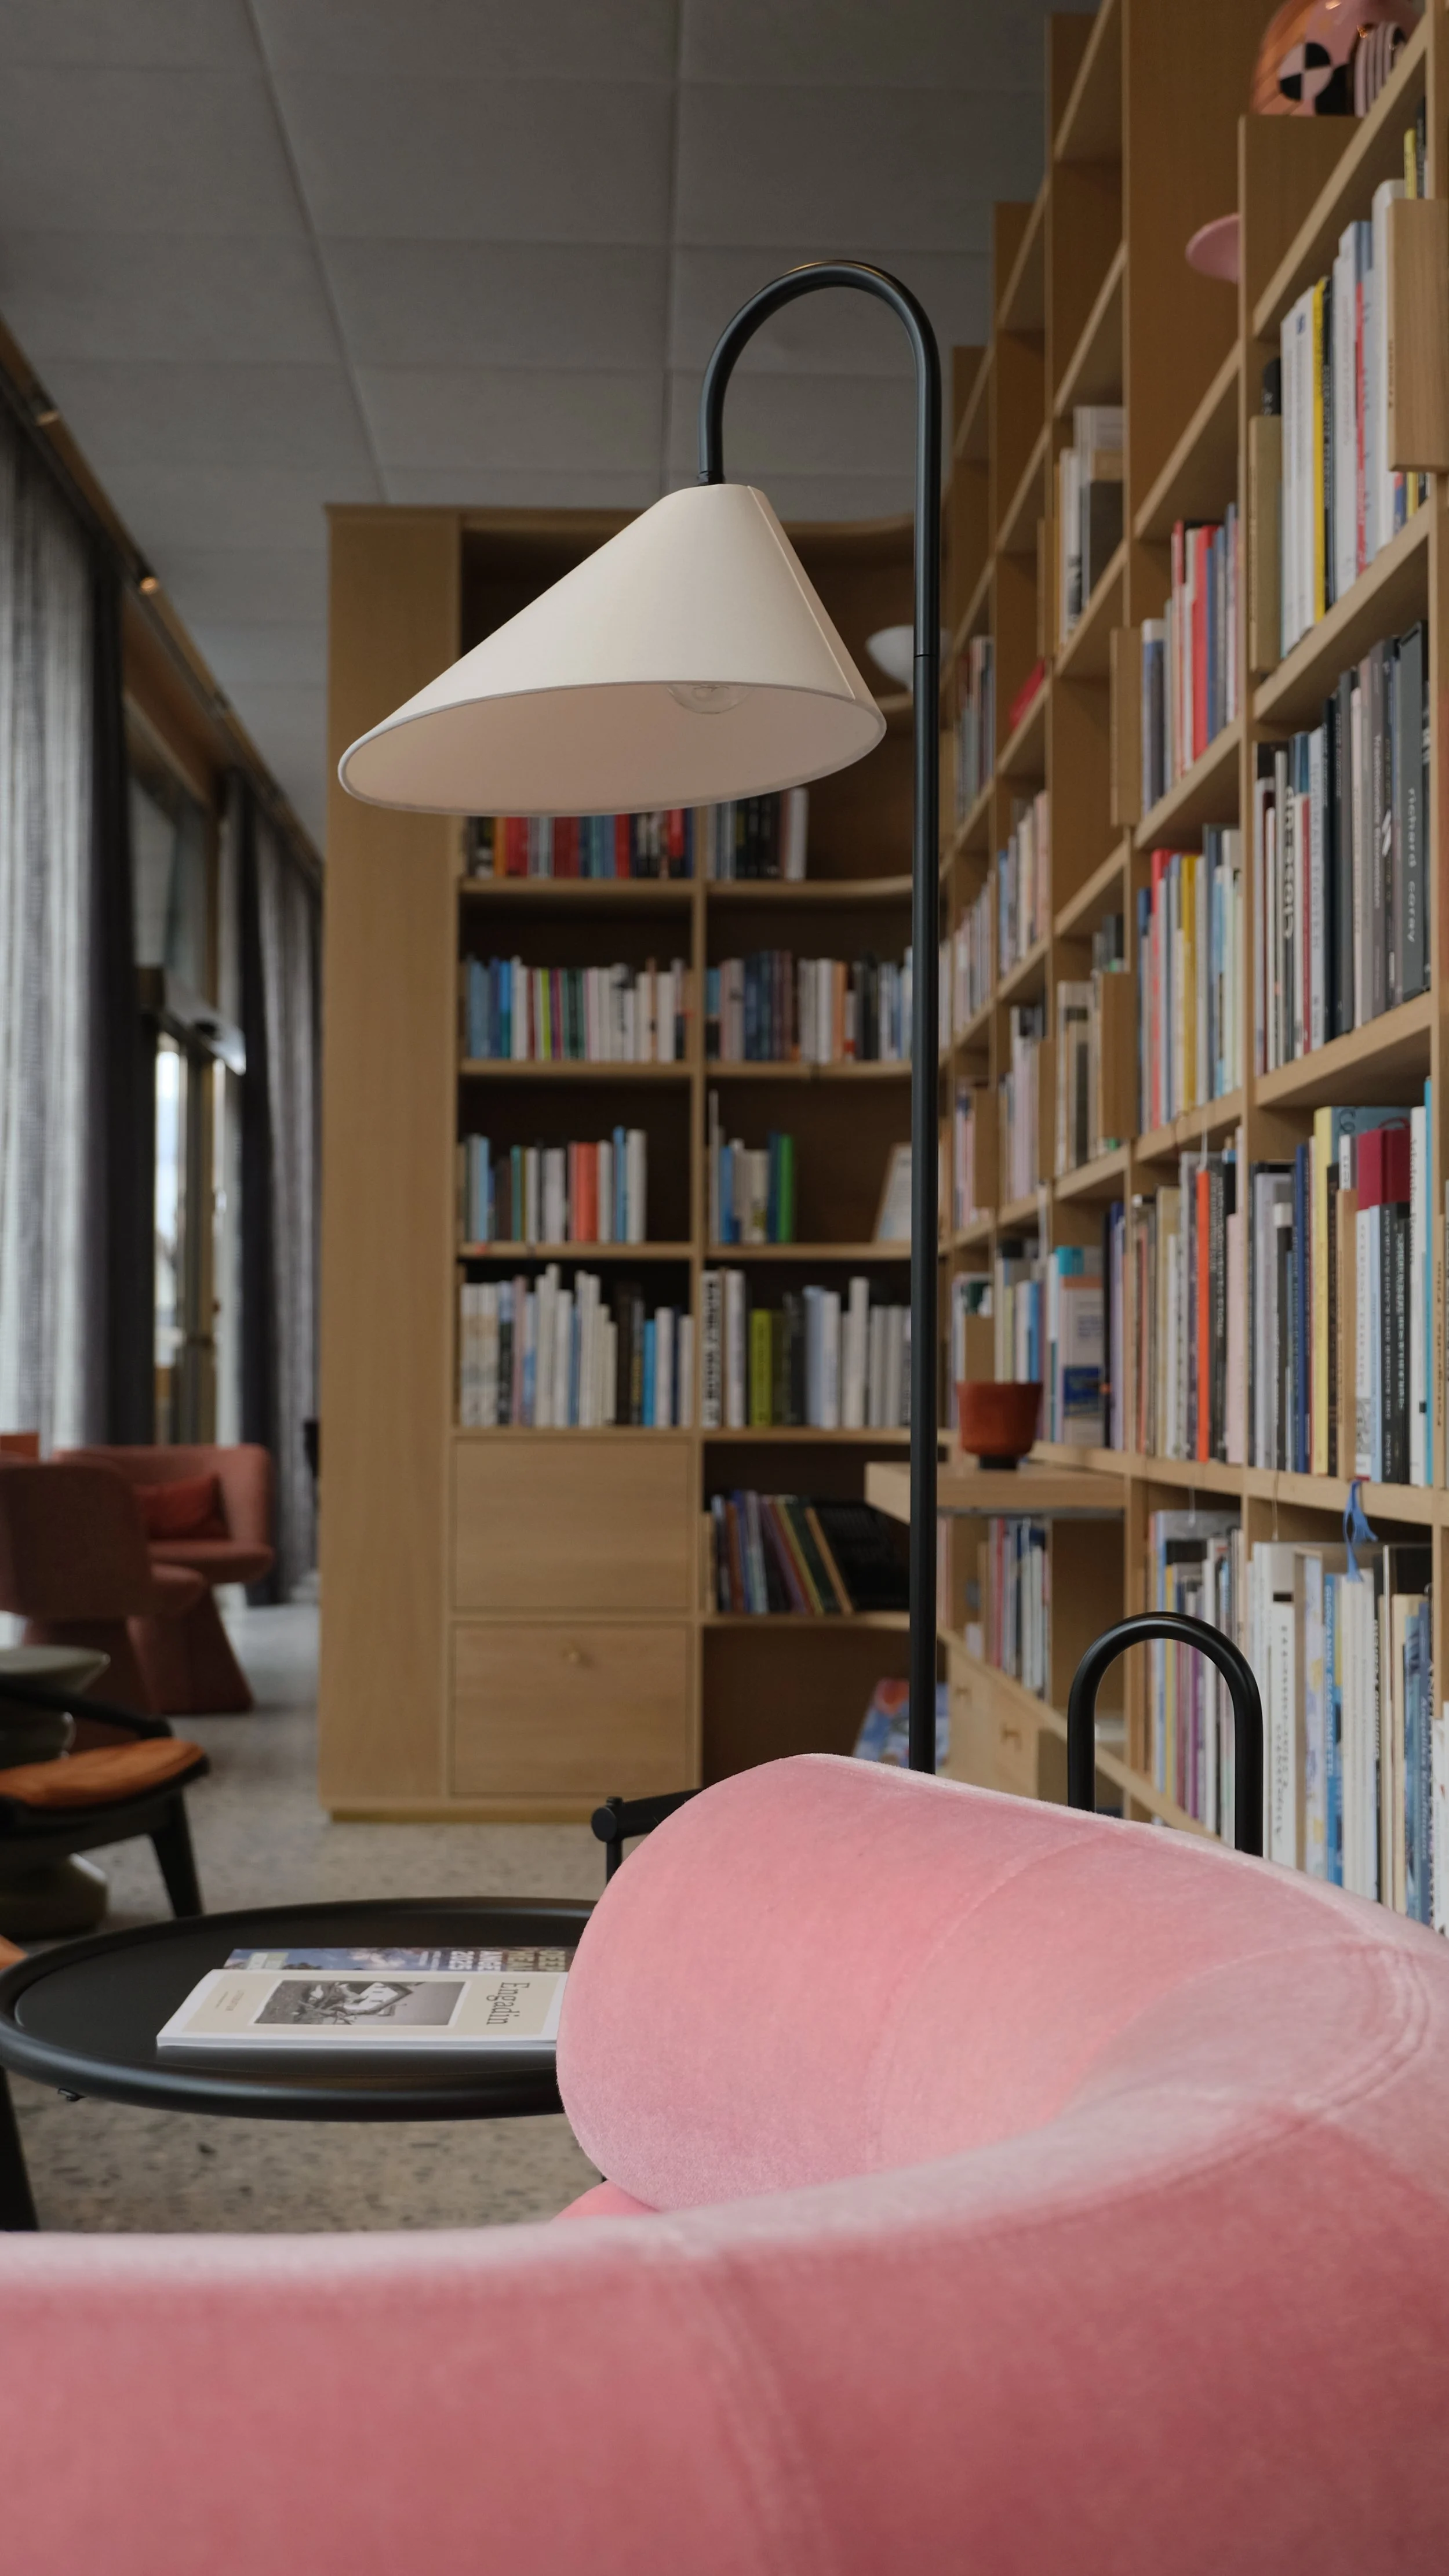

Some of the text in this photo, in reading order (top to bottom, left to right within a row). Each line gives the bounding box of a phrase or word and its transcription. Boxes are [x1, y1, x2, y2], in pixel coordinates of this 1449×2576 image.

[1407, 788, 1417, 943] richard coray
[1326, 1585, 1334, 1778] GIOVANNI GIACOMETTI
[1421, 1695, 1429, 1861] Angelika Kauffmann
[448, 1950, 475, 1970] 2025
[486, 1982, 530, 2025] Engadin
